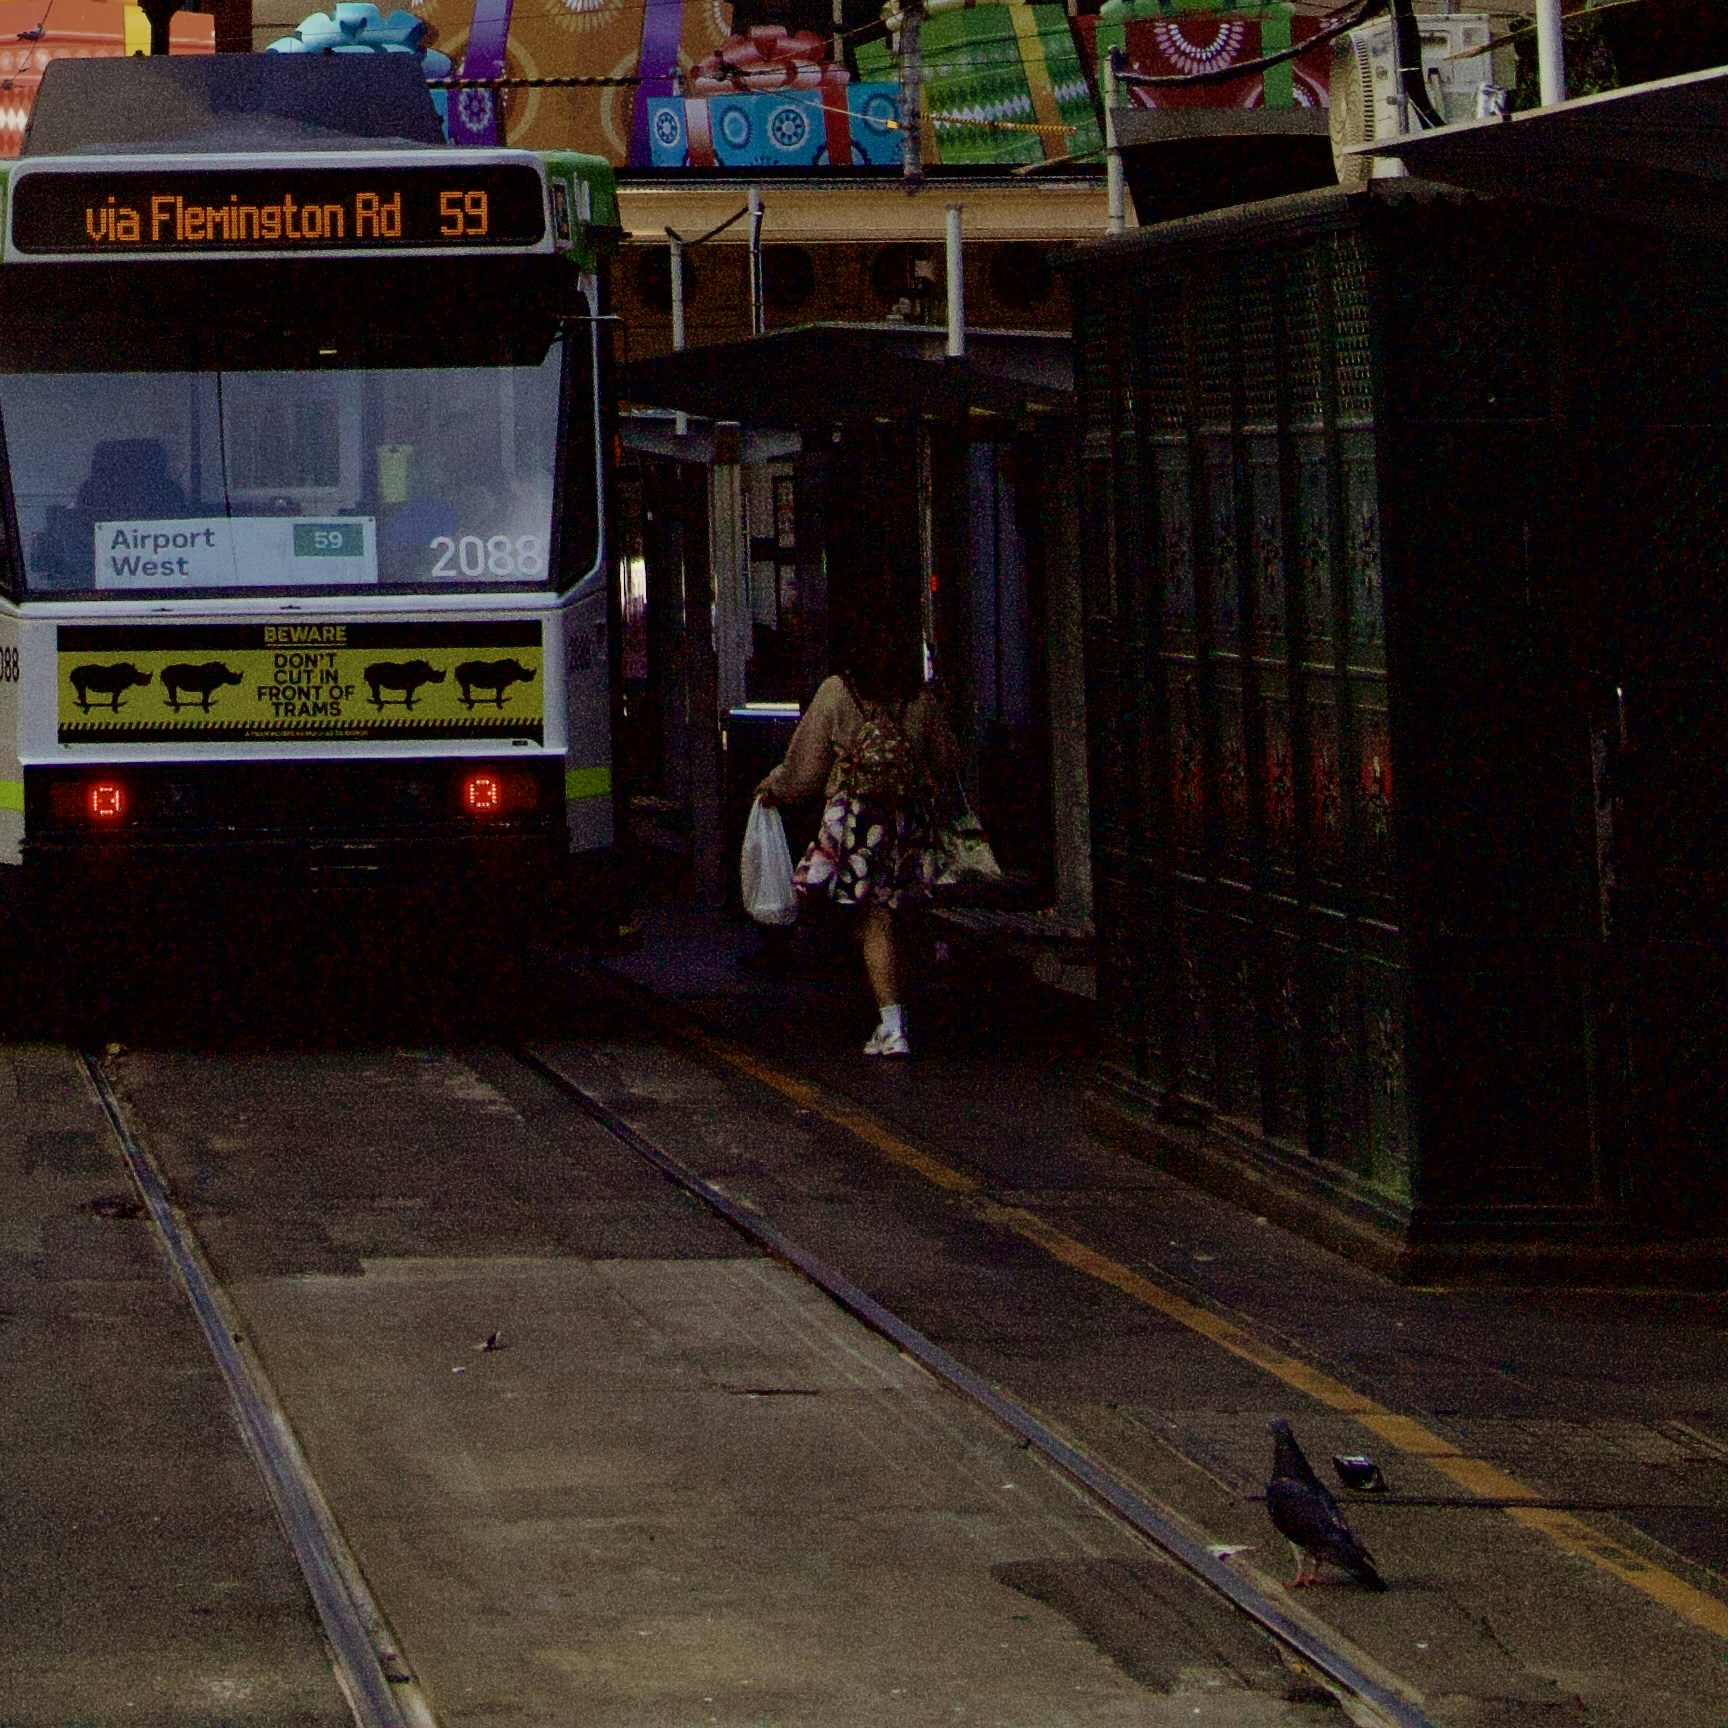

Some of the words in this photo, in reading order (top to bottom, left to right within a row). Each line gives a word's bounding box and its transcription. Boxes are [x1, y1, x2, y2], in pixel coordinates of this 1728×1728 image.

[86, 195, 140, 241] via
[151, 193, 344, 241] Flemington
[356, 191, 402, 238] Rd
[439, 190, 488, 236] 59
[111, 527, 215, 551] Airport
[314, 530, 343, 549] 59
[429, 535, 544, 578] 2088
[111, 554, 189, 577] West
[264, 626, 347, 642] BEWARE
[273, 652, 337, 668] DON'T
[273, 669, 312, 685] CUT
[320, 669, 338, 684] IN
[257, 685, 322, 701] FRONT
[329, 685, 355, 700] OF
[271, 701, 342, 717] TRAMS
